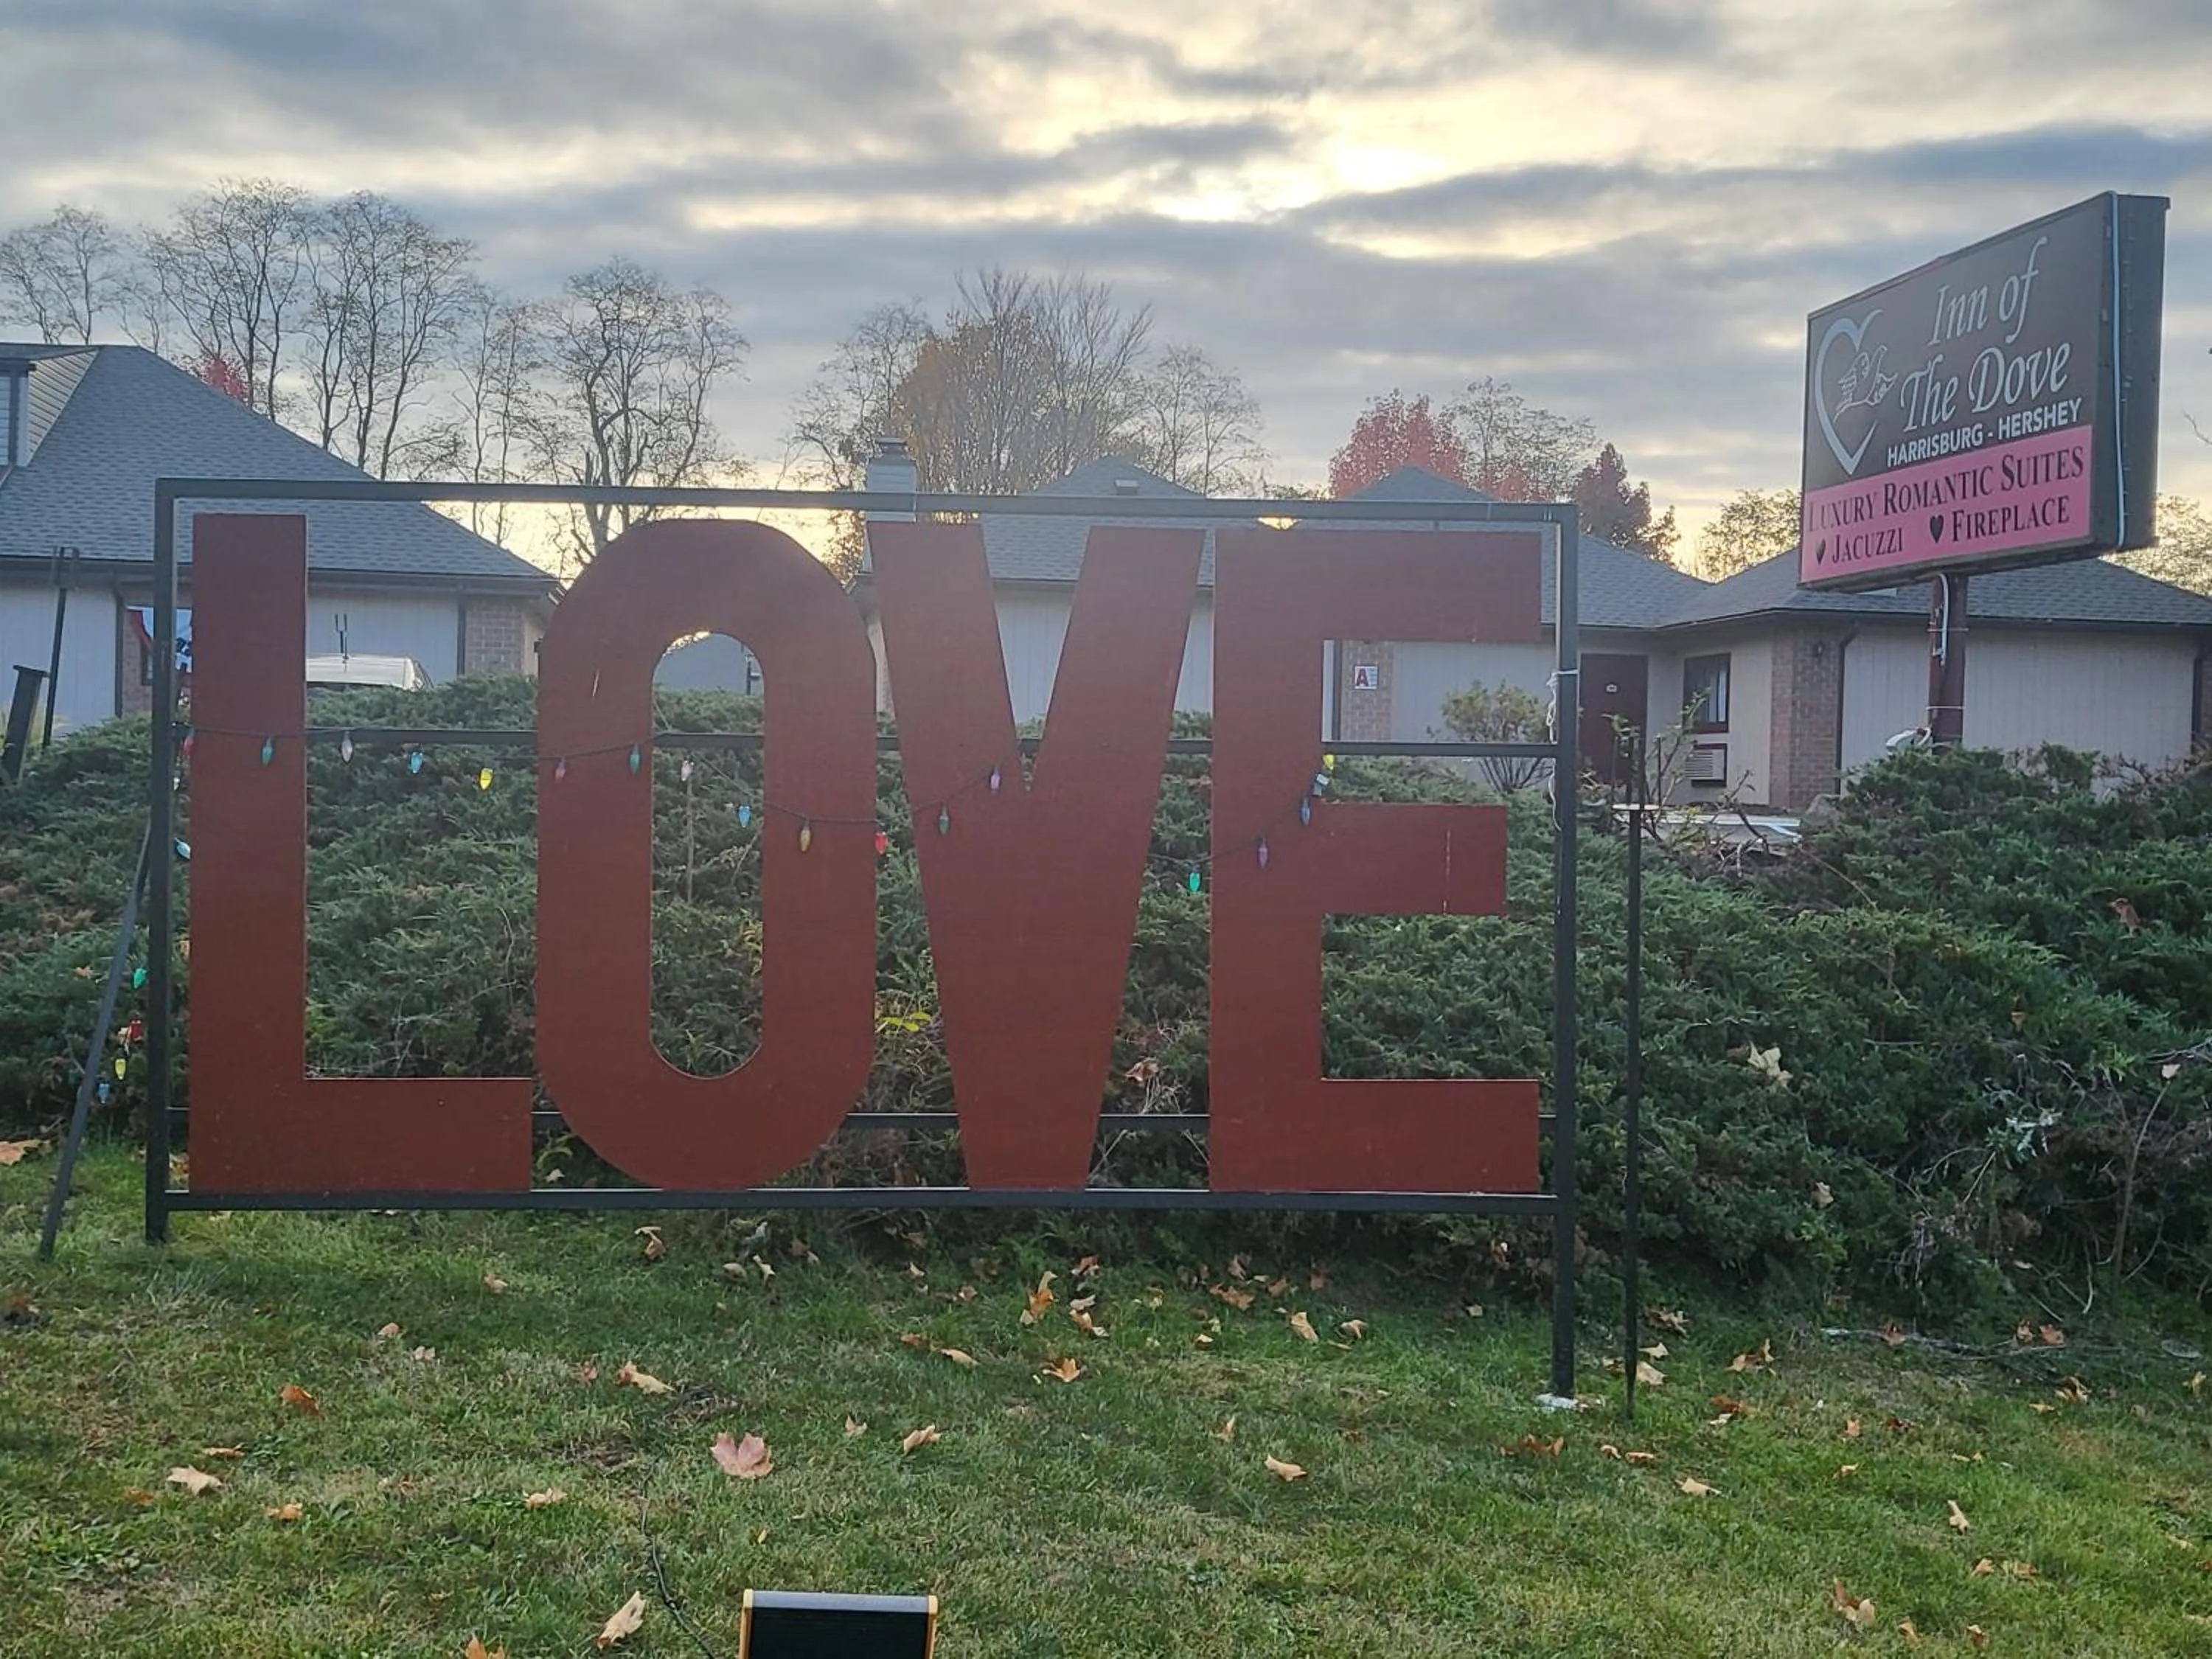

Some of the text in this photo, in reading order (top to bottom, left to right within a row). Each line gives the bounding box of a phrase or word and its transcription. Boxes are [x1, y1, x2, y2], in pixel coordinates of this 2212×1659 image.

[1927, 235, 2048, 346] Inn of
[1899, 342, 2070, 432] The Dove
[1887, 423, 1983, 467] HARRISBURG
[1998, 397, 2081, 440] HERSHEY
[1884, 465, 1994, 516] ROMANTIC
[2000, 445, 2084, 492] SUITES
[1832, 495, 2070, 564] JACUZZI FIREPLACE
[1357, 667, 1369, 686] A
[189, 514, 1542, 1194] LOVE
